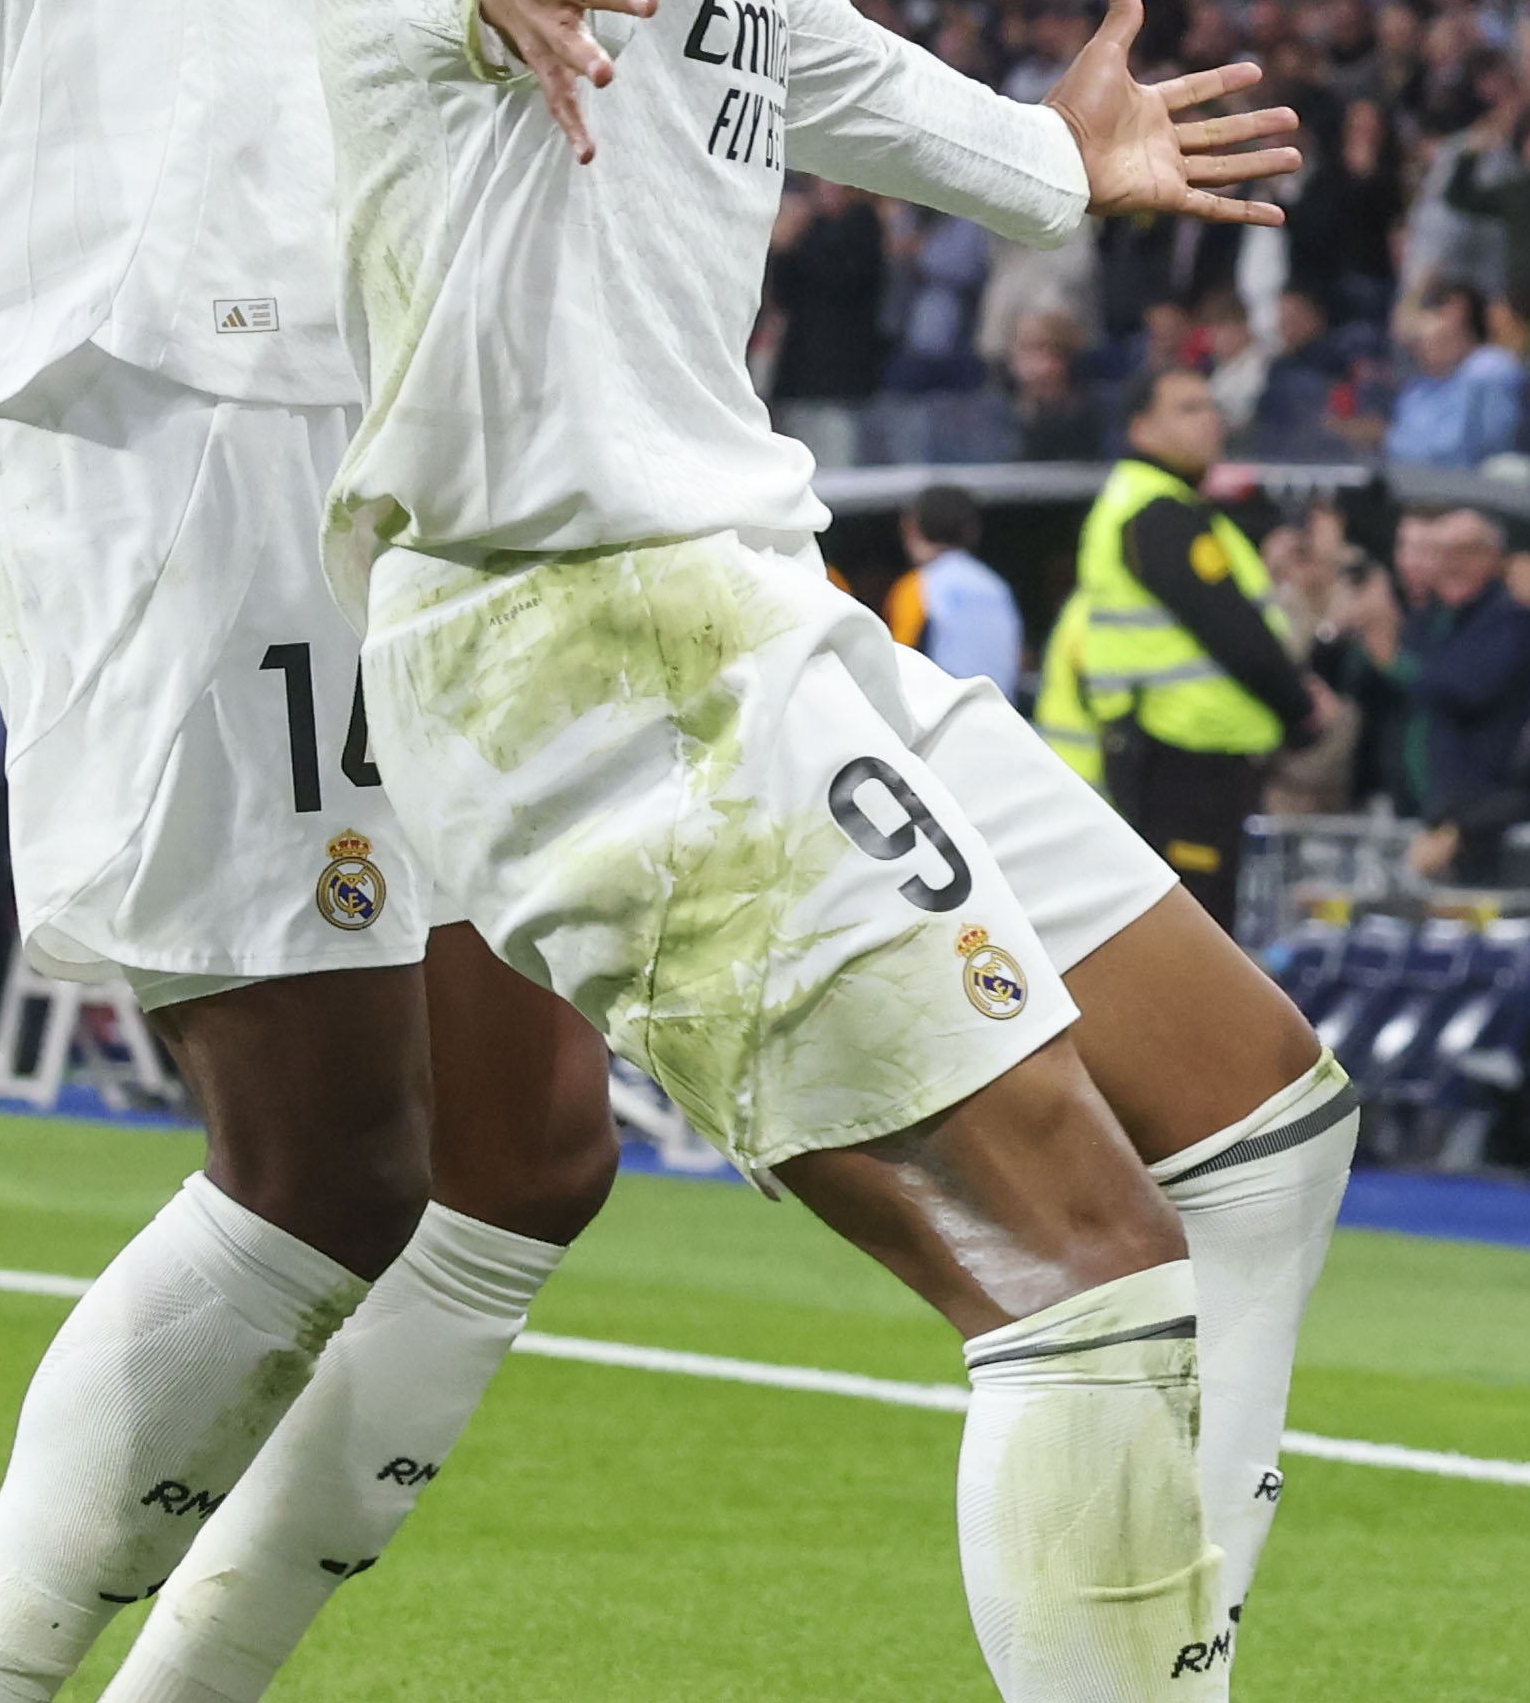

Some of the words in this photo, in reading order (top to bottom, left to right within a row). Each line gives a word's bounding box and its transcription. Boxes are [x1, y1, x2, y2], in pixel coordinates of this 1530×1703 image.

[708, 88, 763, 164] FLY
[828, 756, 972, 913] 9
[141, 1480, 227, 1519] RM
[1171, 1628, 1230, 1679] RM
